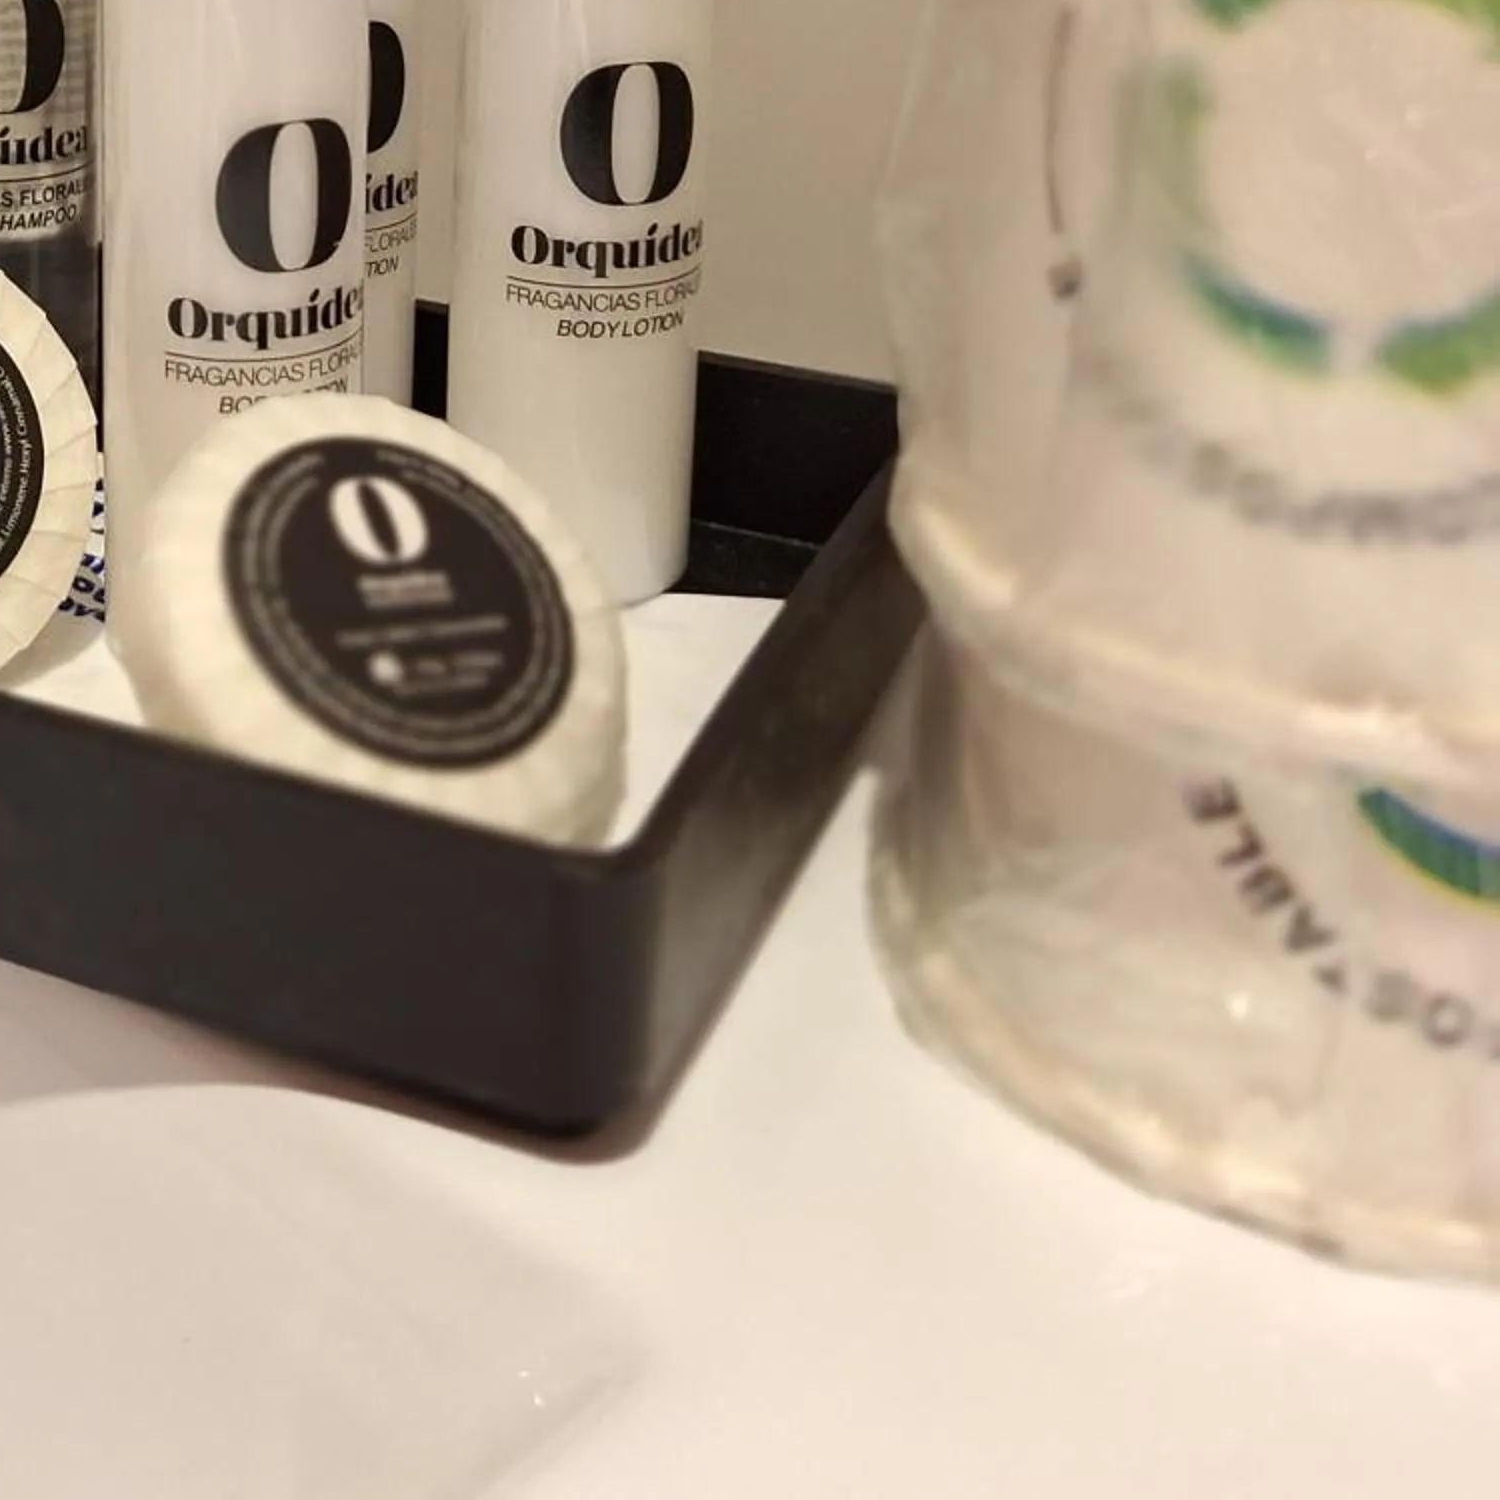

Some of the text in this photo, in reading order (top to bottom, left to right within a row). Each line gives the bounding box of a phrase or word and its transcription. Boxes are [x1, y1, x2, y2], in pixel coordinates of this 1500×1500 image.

[560, 61, 694, 206] O
[215, 117, 352, 273] O
[506, 283, 641, 313] FRAGANCIAS
[556, 310, 686, 339] BODY LOTION
[164, 358, 305, 387] FRAGANCIAS
